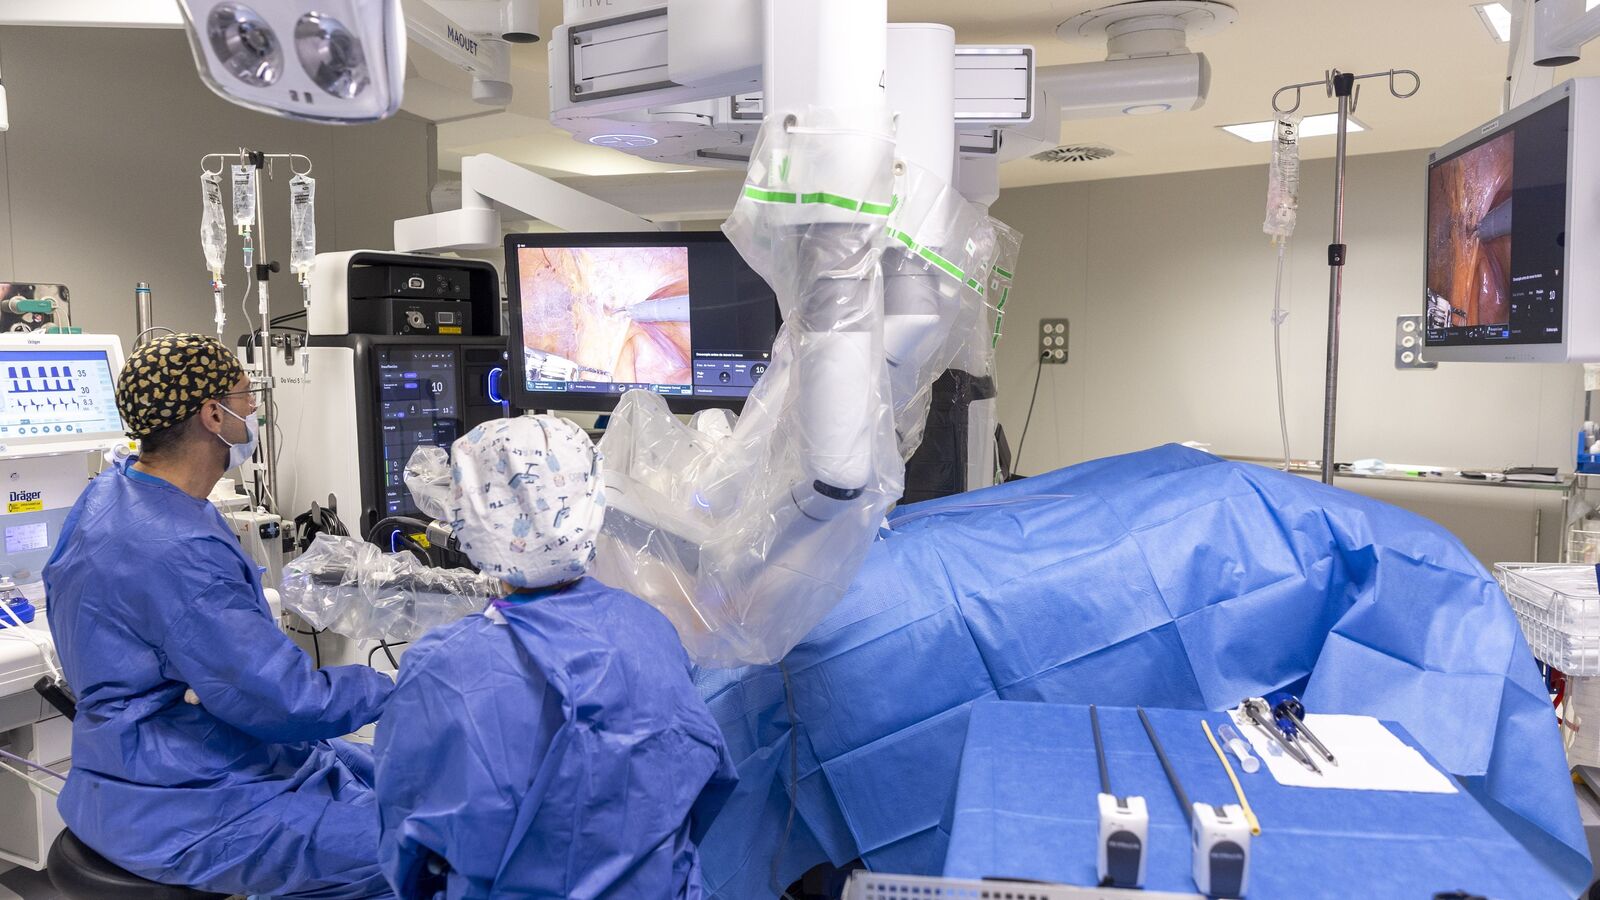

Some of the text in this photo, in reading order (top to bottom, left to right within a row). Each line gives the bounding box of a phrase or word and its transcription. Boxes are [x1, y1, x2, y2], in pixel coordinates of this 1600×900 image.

[447, 25, 478, 56] MAQUET
[77, 369, 87, 378] 35
[80, 386, 90, 394] 30
[431, 381, 443, 392] 10
[9, 490, 42, 502] Dräger
